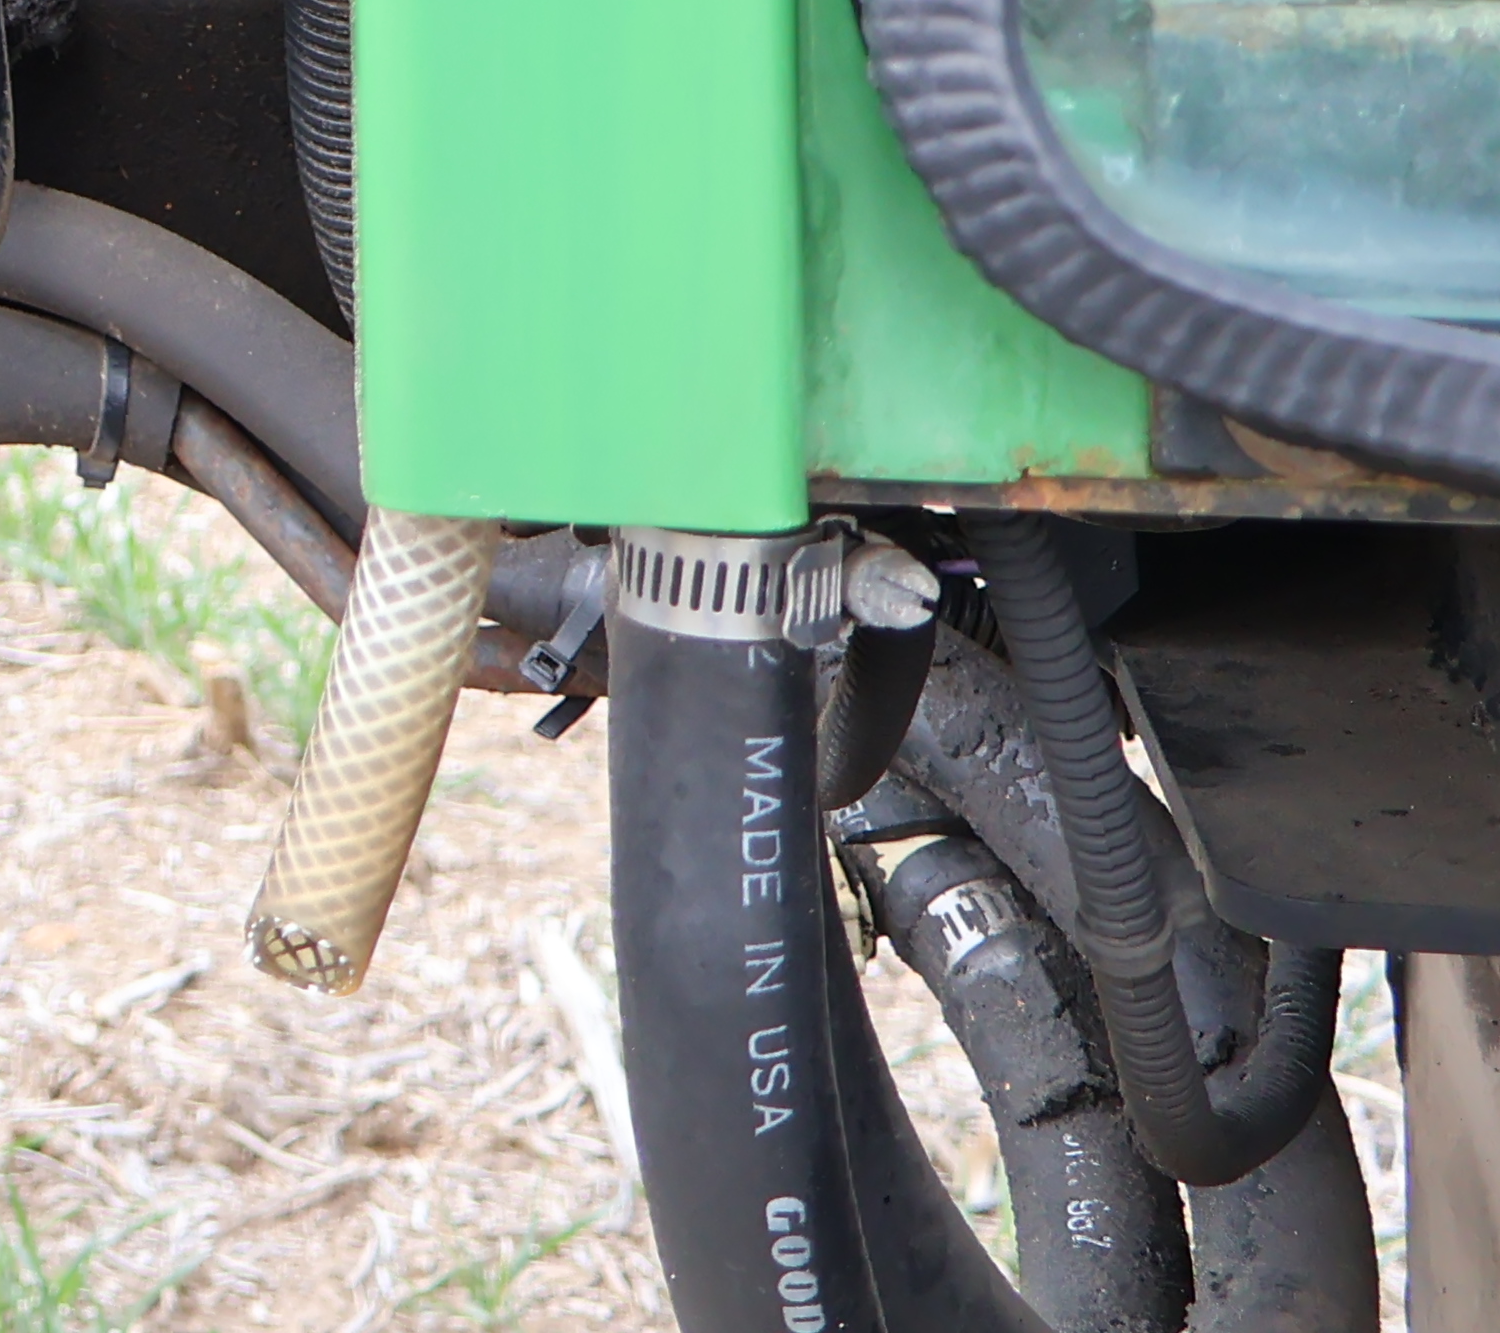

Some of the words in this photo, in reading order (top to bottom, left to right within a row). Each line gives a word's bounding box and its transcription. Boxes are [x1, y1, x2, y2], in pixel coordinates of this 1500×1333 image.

[741, 735, 784, 908] MADE
[745, 940, 785, 996] IN
[748, 1024, 794, 1137] USA
